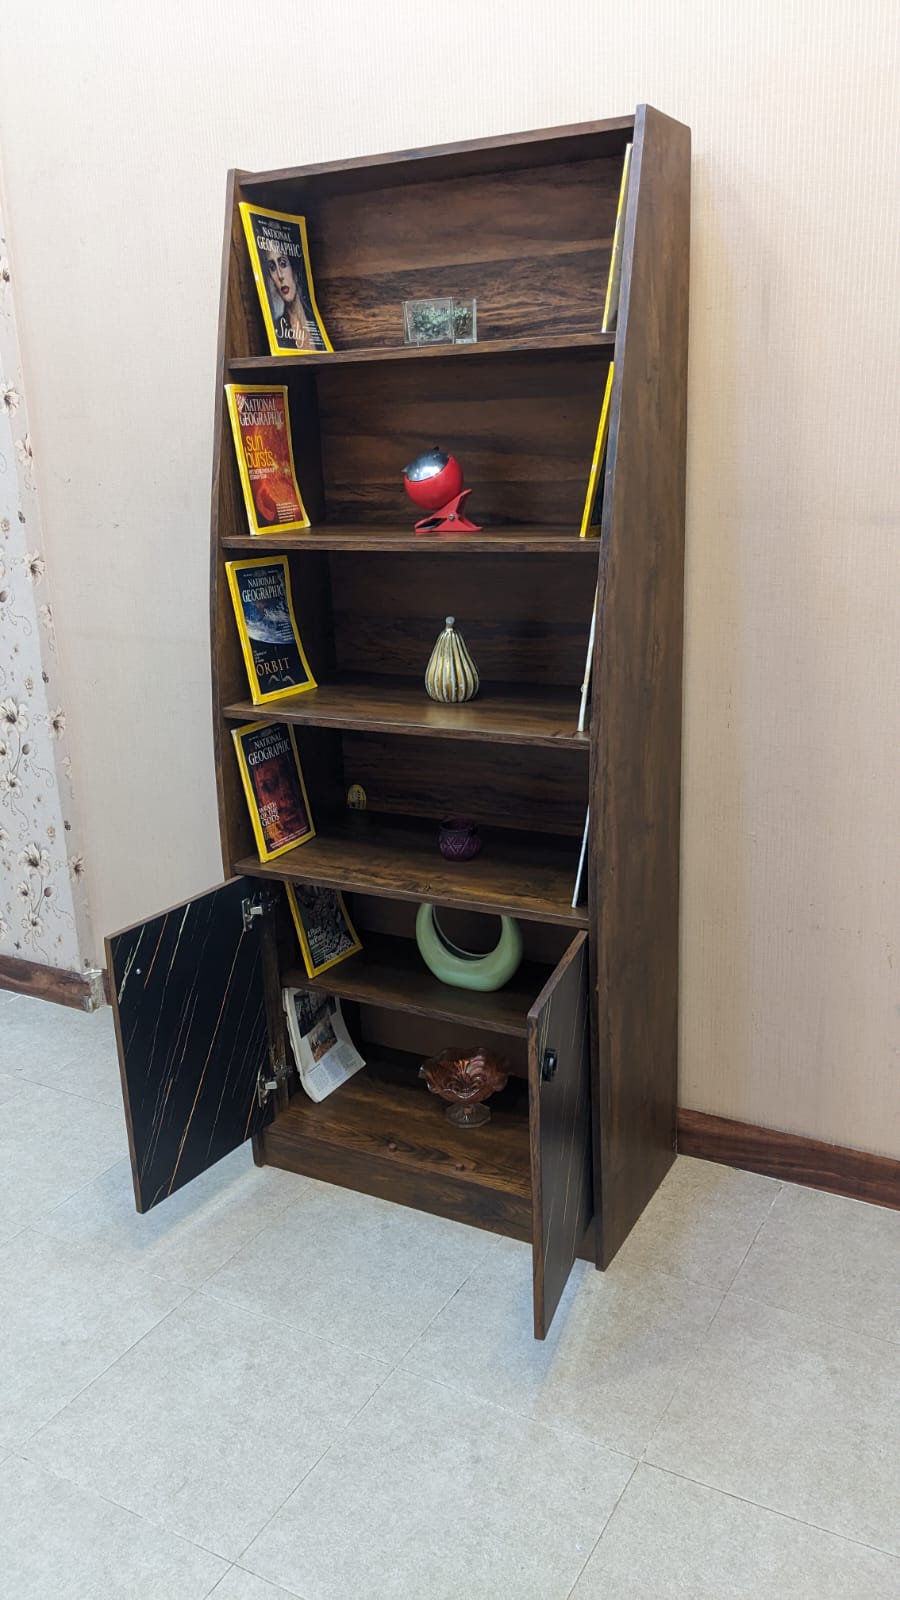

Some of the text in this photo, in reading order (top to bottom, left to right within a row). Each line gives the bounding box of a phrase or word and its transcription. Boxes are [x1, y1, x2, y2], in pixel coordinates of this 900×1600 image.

[262, 227, 292, 242] NATIONAL
[256, 235, 302, 258] GEOGRAPHIC
[275, 317, 306, 348] Sicily
[244, 398, 277, 412] NATIONAL
[240, 410, 285, 426] GEOGRAPHIC
[247, 576, 277, 587] NATIONAL
[242, 584, 285, 602] GEOGRAPHIC
[256, 657, 289, 677] ORBIT
[254, 731, 283, 750] NATIONAL
[248, 738, 291, 766] GEOGRAPHIC
[261, 814, 280, 827] GODS
